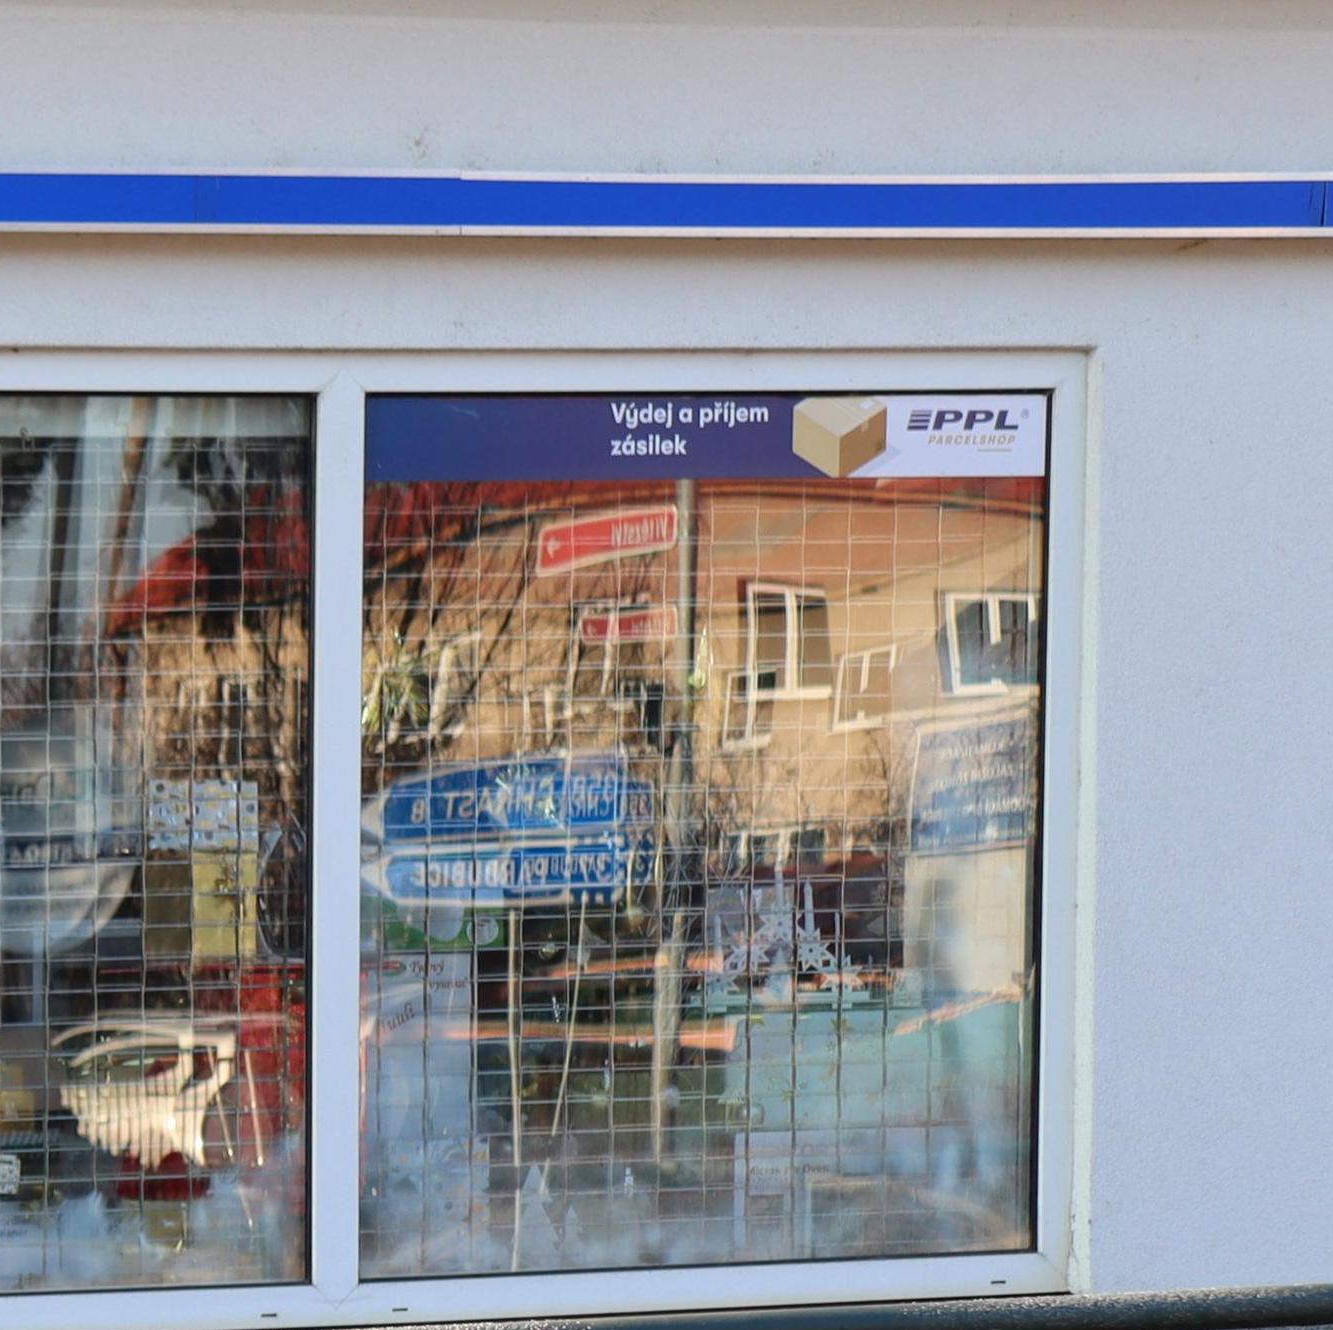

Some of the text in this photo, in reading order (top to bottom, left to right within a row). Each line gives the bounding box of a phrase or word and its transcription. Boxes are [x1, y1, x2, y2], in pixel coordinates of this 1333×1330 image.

[611, 401, 769, 429] Výdej a příjem
[933, 409, 1019, 431] PPL
[611, 434, 687, 456] zásilek
[928, 434, 1016, 446] PARCELSHOP
